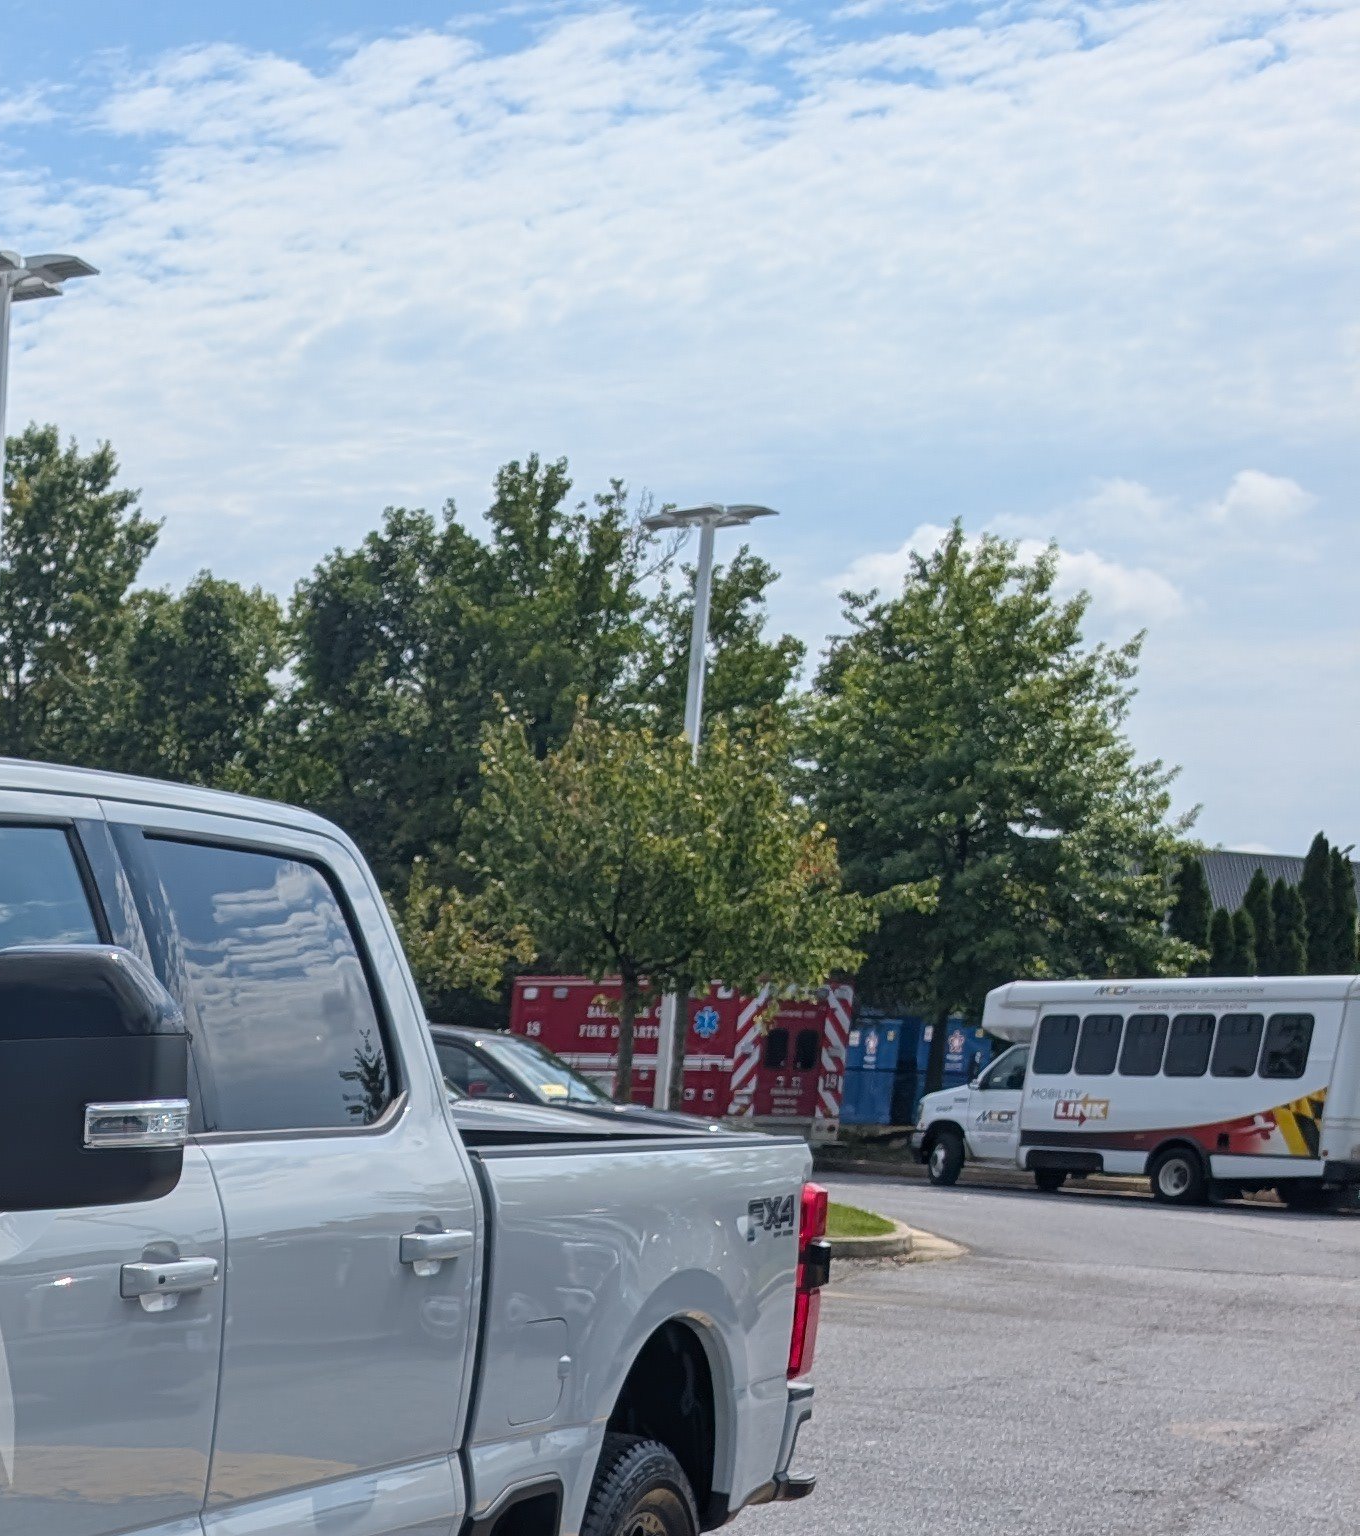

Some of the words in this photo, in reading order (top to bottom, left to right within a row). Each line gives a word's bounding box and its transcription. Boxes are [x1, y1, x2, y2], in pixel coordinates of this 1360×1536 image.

[1030, 1087, 1082, 1100] MOBILITY
[1056, 1101, 1107, 1119] LINK
[747, 1194, 795, 1242] FX4
